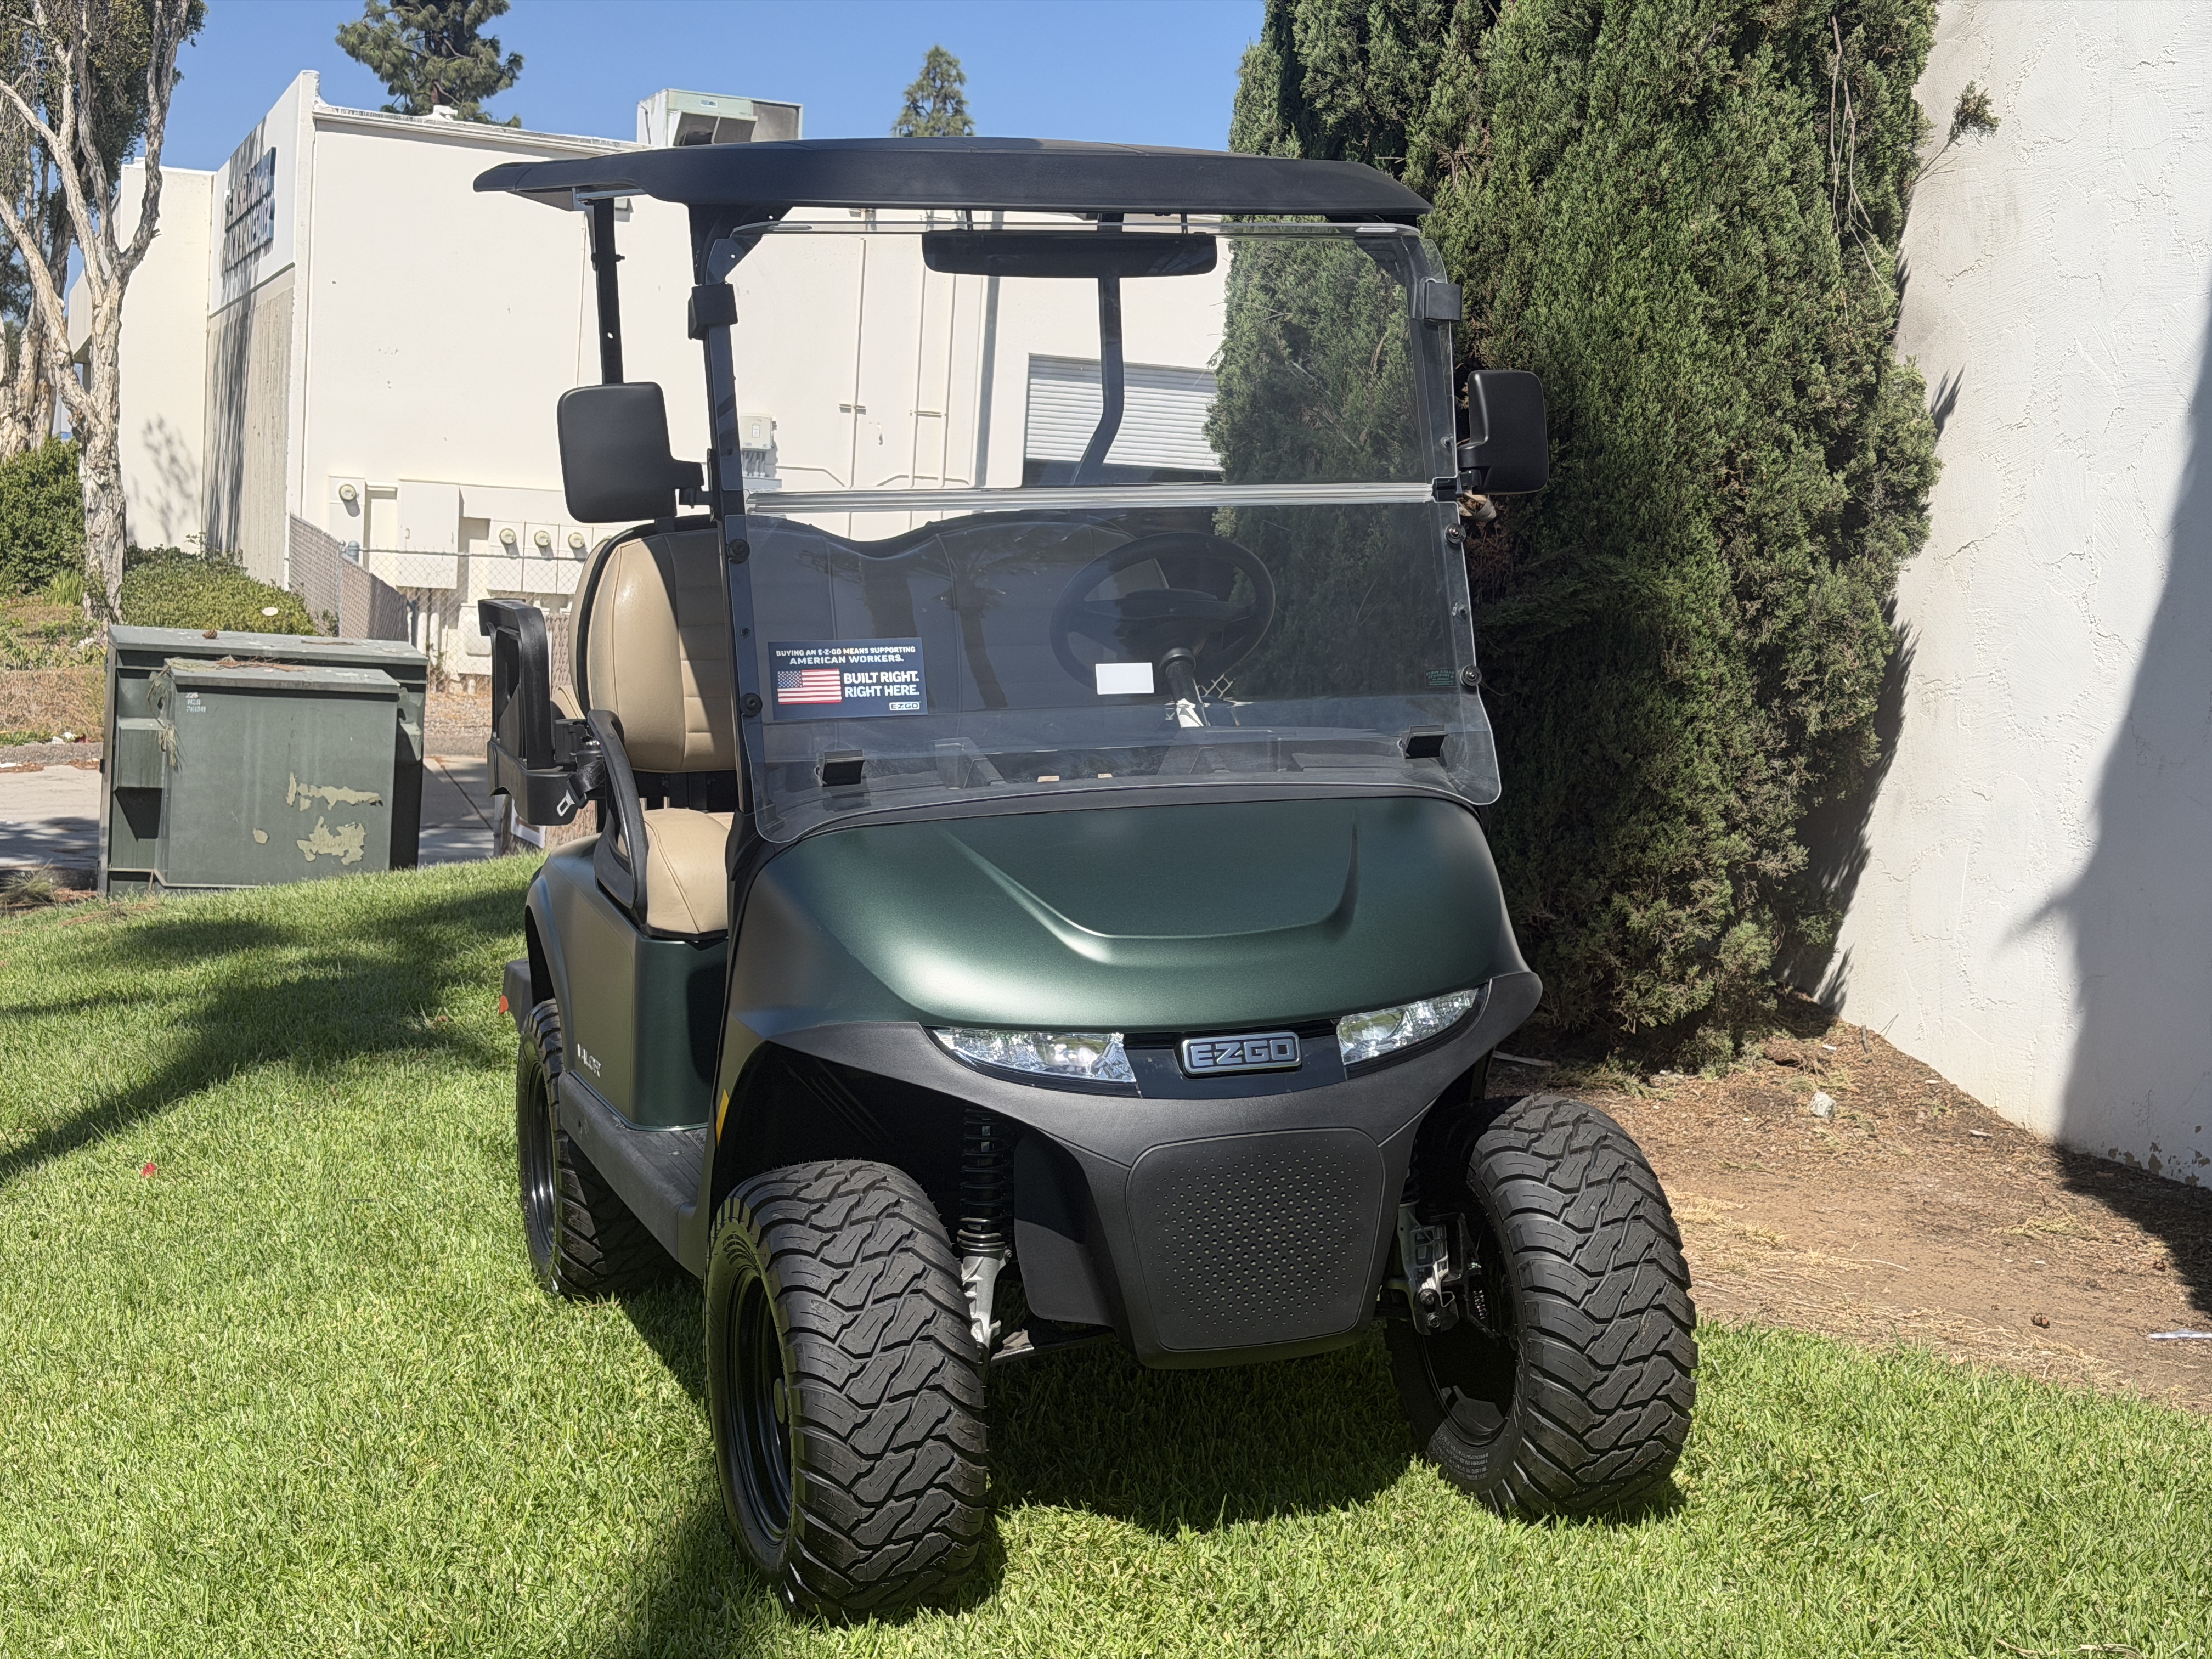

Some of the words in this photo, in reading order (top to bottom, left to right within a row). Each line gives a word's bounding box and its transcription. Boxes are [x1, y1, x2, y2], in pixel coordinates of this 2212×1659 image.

[789, 656, 846, 665] AMERICAN
[849, 654, 904, 663] WORKERS.
[843, 672, 879, 685] BUILT
[881, 670, 919, 683] RIGHT.
[845, 685, 883, 698] RIGHT
[884, 684, 920, 696] HERE.
